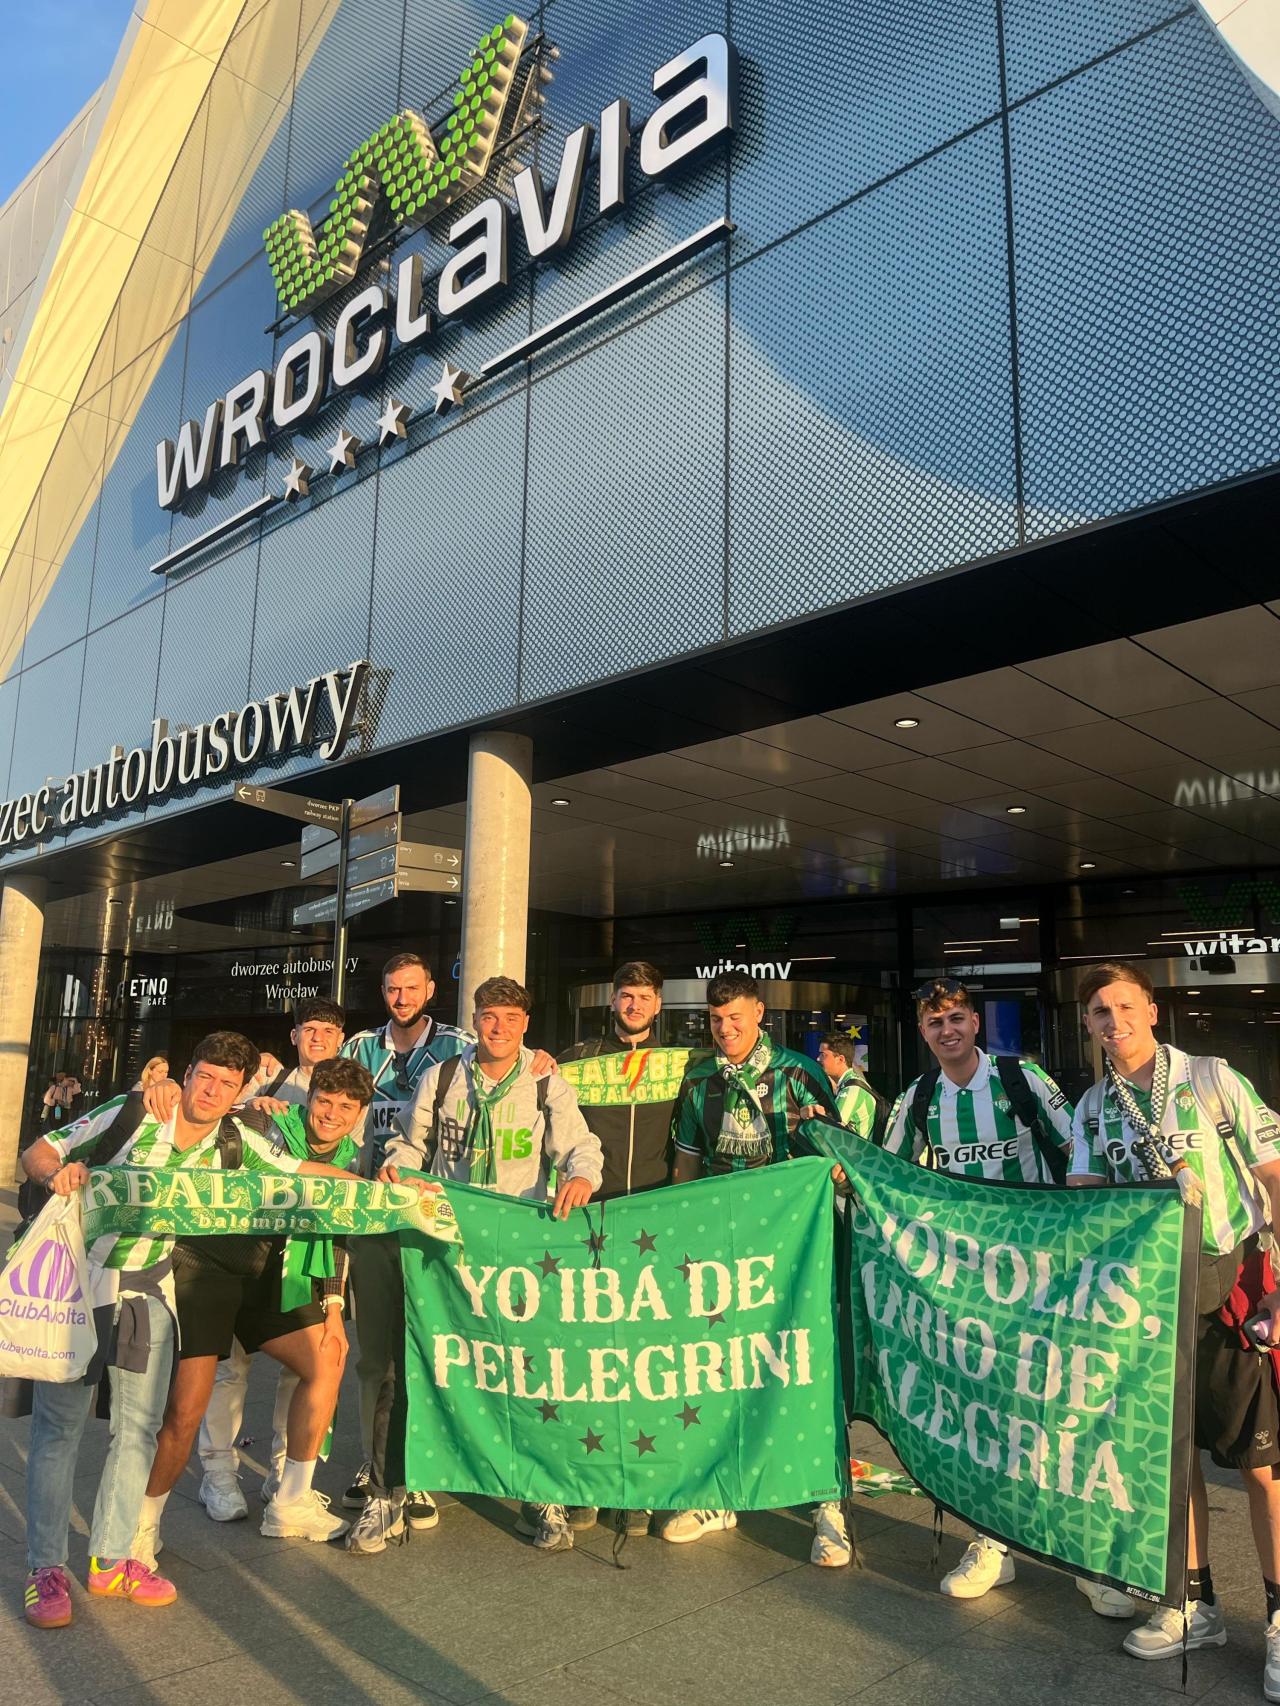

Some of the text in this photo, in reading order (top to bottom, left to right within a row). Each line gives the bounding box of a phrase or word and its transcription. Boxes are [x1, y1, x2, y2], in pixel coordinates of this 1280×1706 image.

[60, 659, 368, 825] autobusowy
[328, 803, 341, 812] PKP
[230, 957, 360, 977] dworzec autobusy
[129, 977, 169, 997] ETNO
[265, 982, 319, 999] Wrocław
[560, 1057, 627, 1086] EAL
[954, 1139, 1018, 1163] GREE
[83, 1170, 419, 1214] REAL BETIS
[453, 1253, 776, 1324] YO IBA DE
[431, 1327, 815, 1404] PELLEGRINI
[1013, 1331, 1120, 1418] DE
